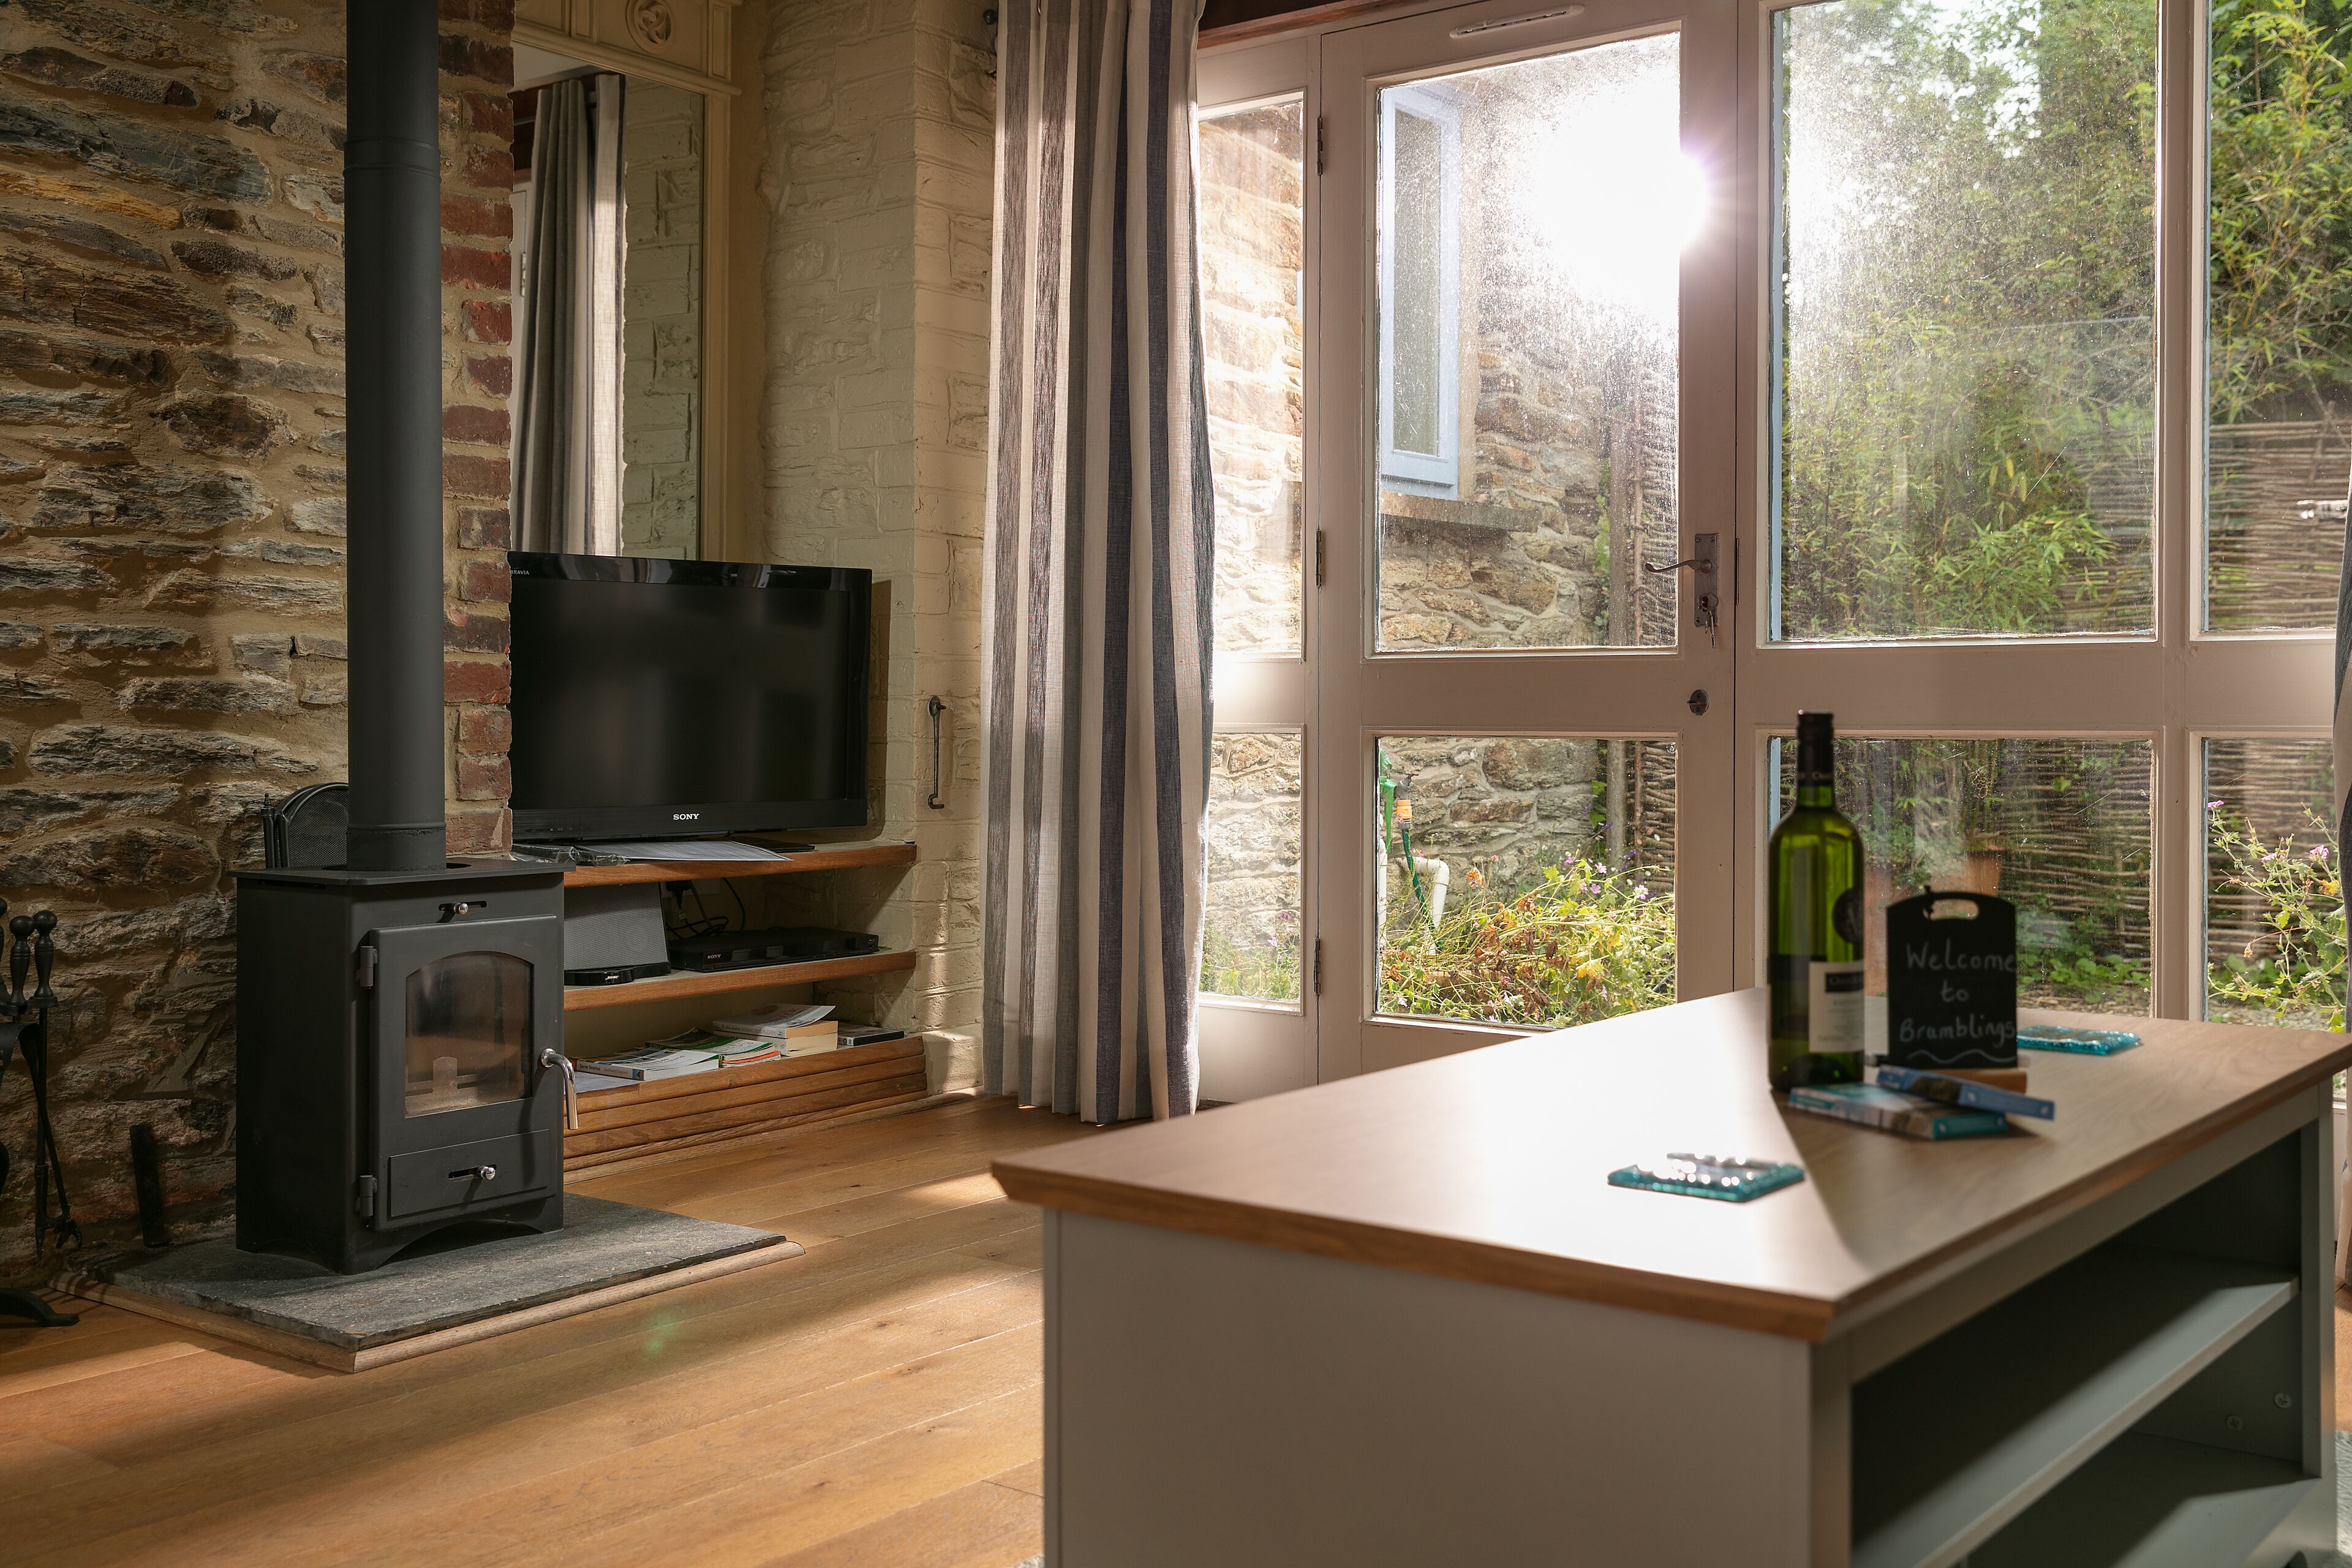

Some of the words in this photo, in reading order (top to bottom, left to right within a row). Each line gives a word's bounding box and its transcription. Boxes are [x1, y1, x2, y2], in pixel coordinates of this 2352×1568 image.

[1905, 938, 2016, 971] Welcome
[1940, 979, 1970, 1003] to
[1899, 1012, 2015, 1048] Bramblings
